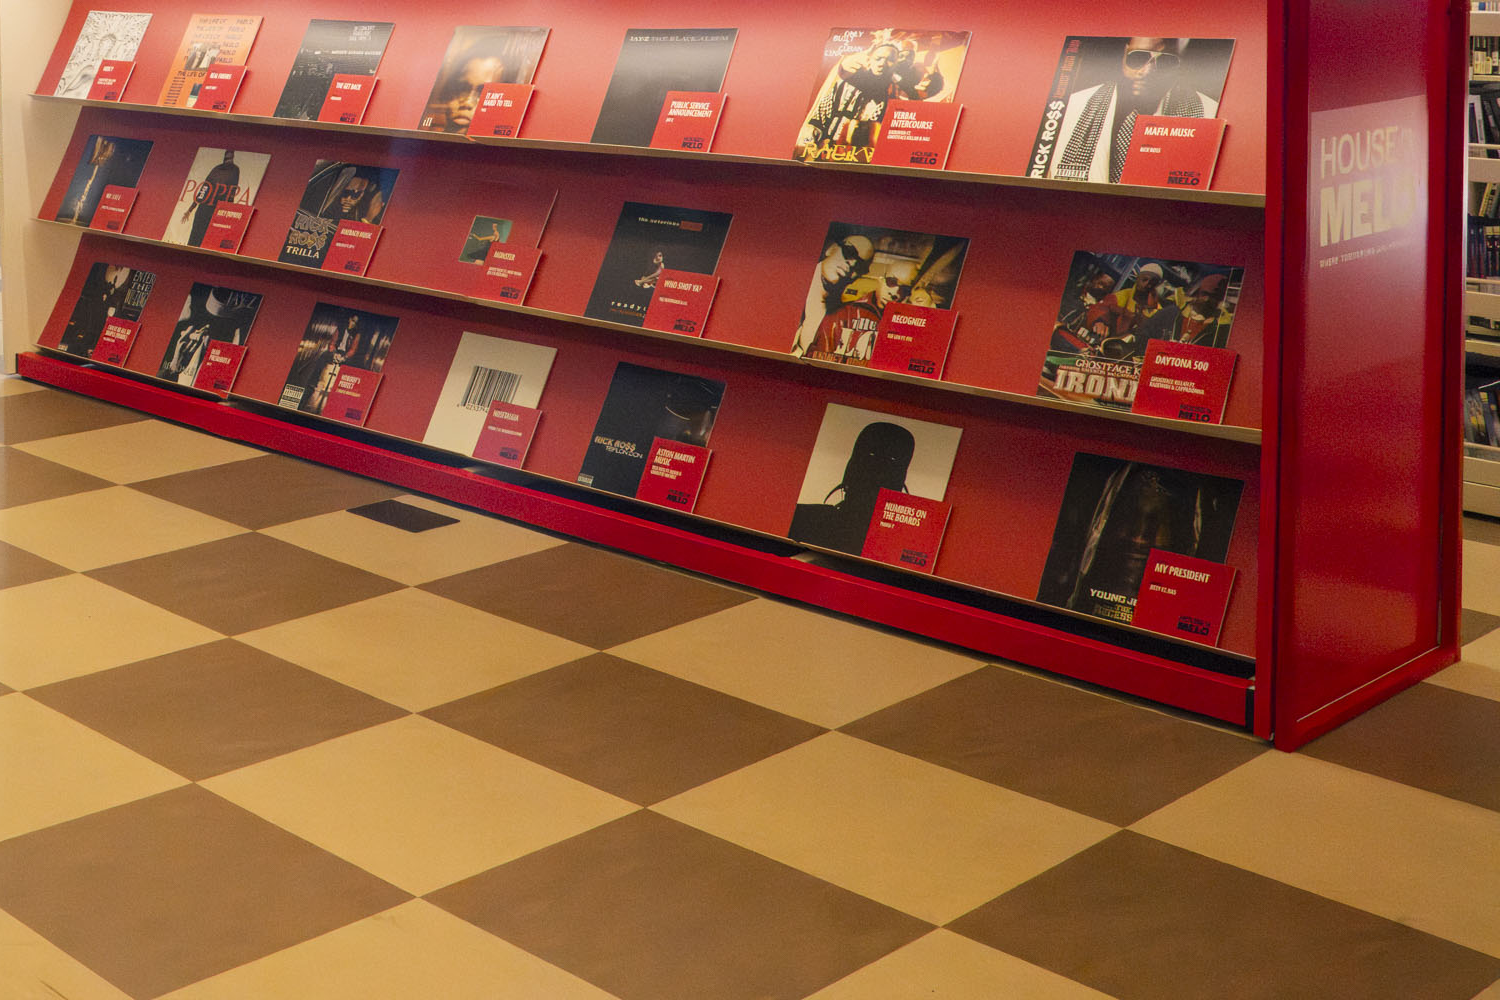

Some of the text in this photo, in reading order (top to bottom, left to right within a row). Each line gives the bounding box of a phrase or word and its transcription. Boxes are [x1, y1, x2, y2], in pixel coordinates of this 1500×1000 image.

[670, 101, 711, 110] PUBLIC SERVICE
[668, 109, 713, 118] ANNOUNCEMENT
[893, 111, 917, 121] VERBAL
[890, 120, 933, 130] INTERCOURSE
[1144, 127, 1196, 138] MAFIA MUSIC
[1320, 126, 1398, 179] HOUSE
[1030, 143, 1052, 178] RICK
[1167, 177, 1199, 186] MELO
[286, 245, 320, 259] TRILLA
[133, 270, 156, 284] ENTER
[132, 282, 152, 291] THE
[664, 280, 677, 289] WHO
[677, 282, 692, 292] SHOT
[892, 314, 927, 327] RECOGNIZE
[1075, 359, 1132, 374] GHOSTFACE
[1155, 355, 1209, 372] DAYTONA 500
[1053, 369, 1139, 402] IRON
[1179, 410, 1210, 422] MELO
[594, 436, 636, 451] RICK ROSS
[654, 457, 672, 466] MUSIC
[656, 448, 696, 463] ASTON MARTIN
[884, 501, 927, 519] NUMBERS ON
[882, 511, 921, 527] THE BOARDS
[1154, 563, 1211, 584] MY PRESIDENT
[1089, 588, 1127, 604] YOUNG
